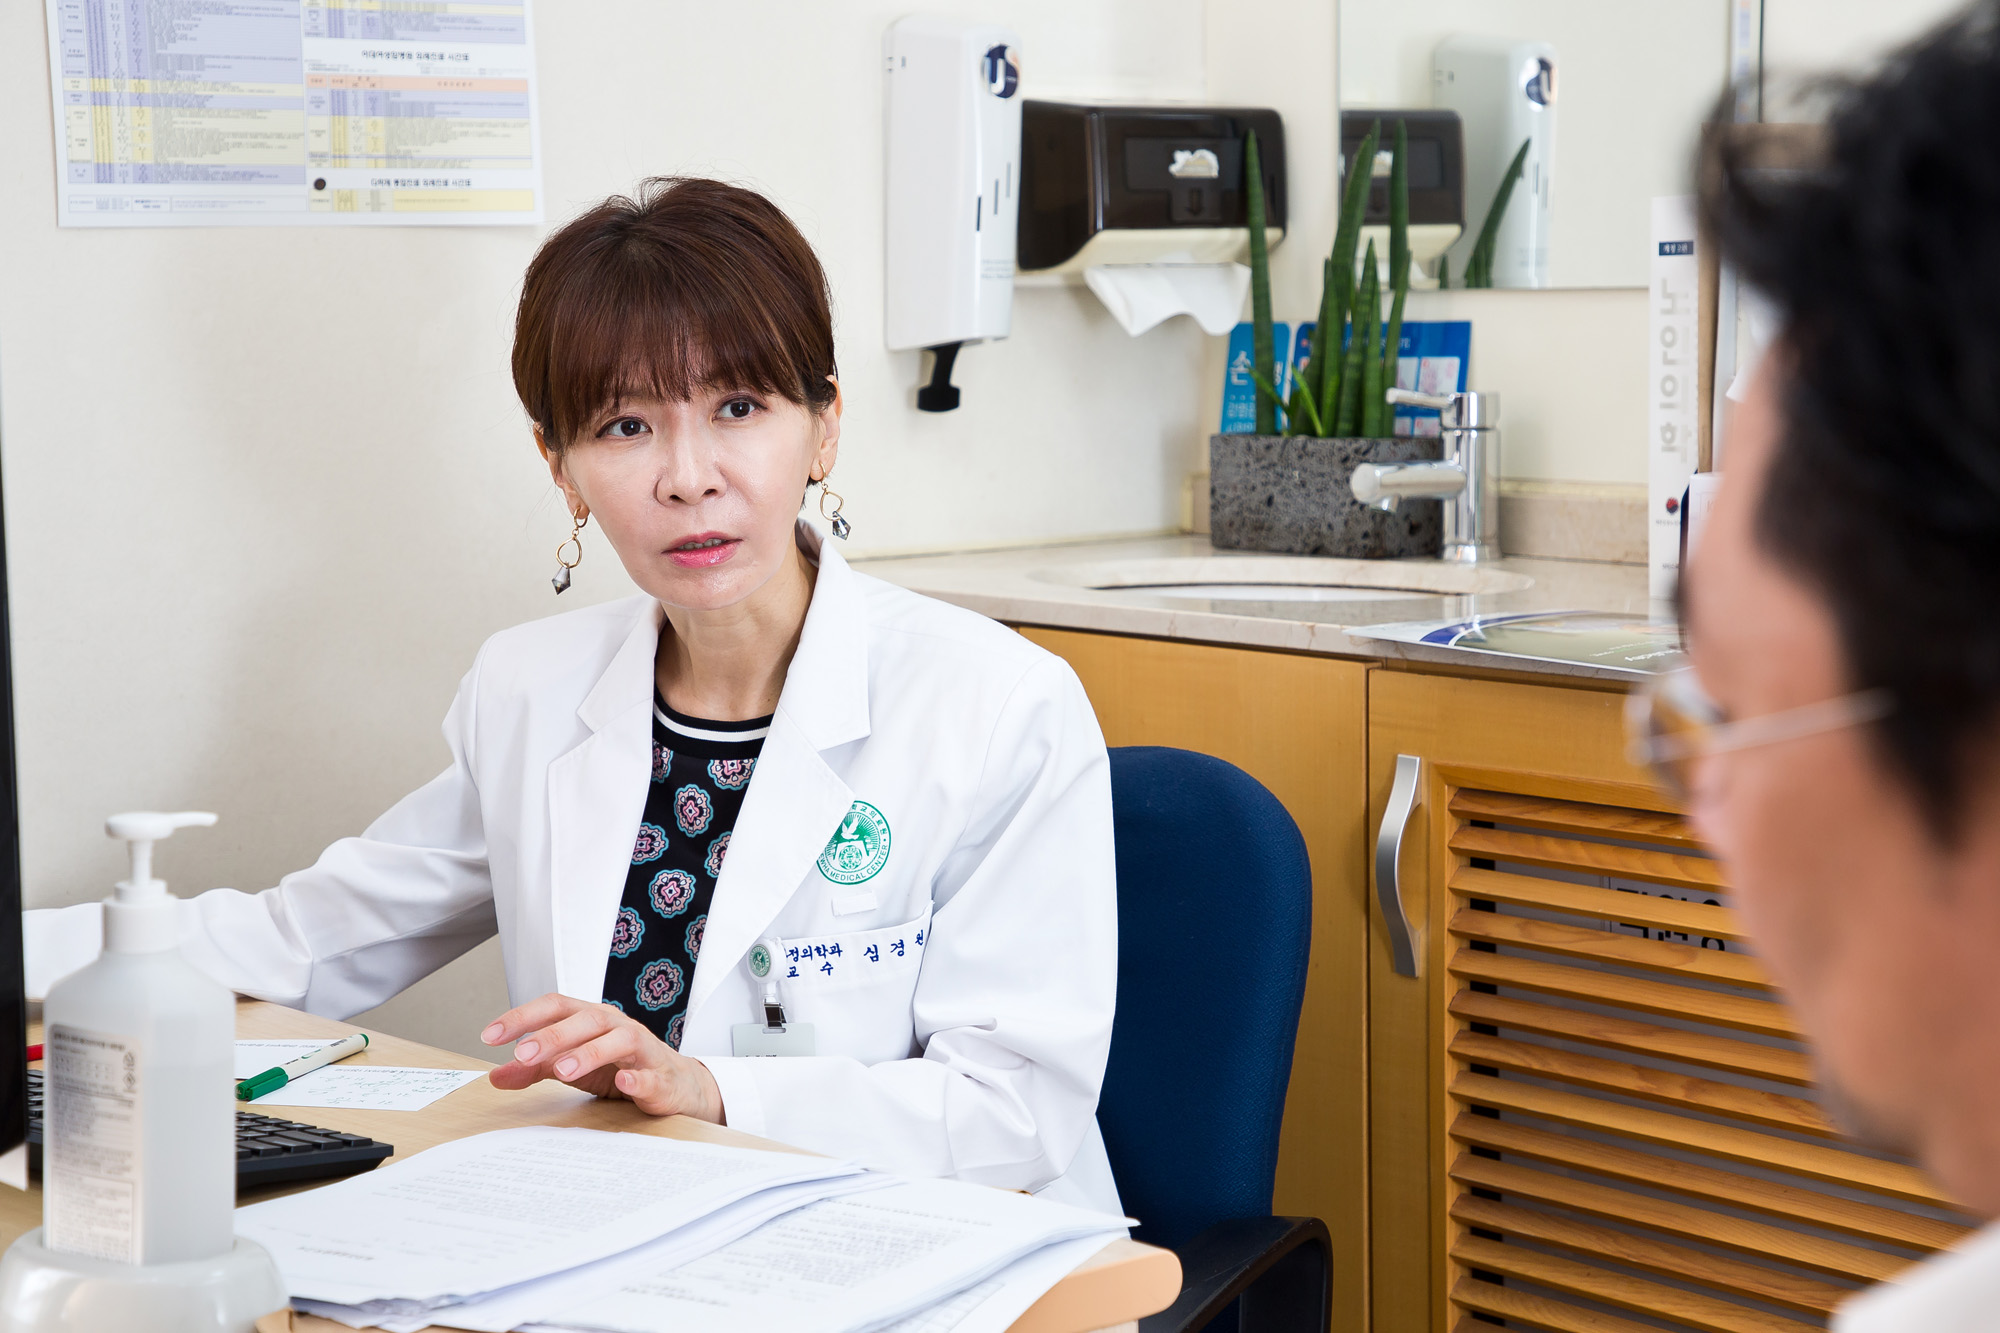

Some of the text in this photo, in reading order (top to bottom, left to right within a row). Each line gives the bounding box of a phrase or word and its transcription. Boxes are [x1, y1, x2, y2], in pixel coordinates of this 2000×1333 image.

[829, 871, 866, 881] MEDICAL
[866, 845, 887, 874] CENTER
[784, 943, 842, 962] 정의학과
